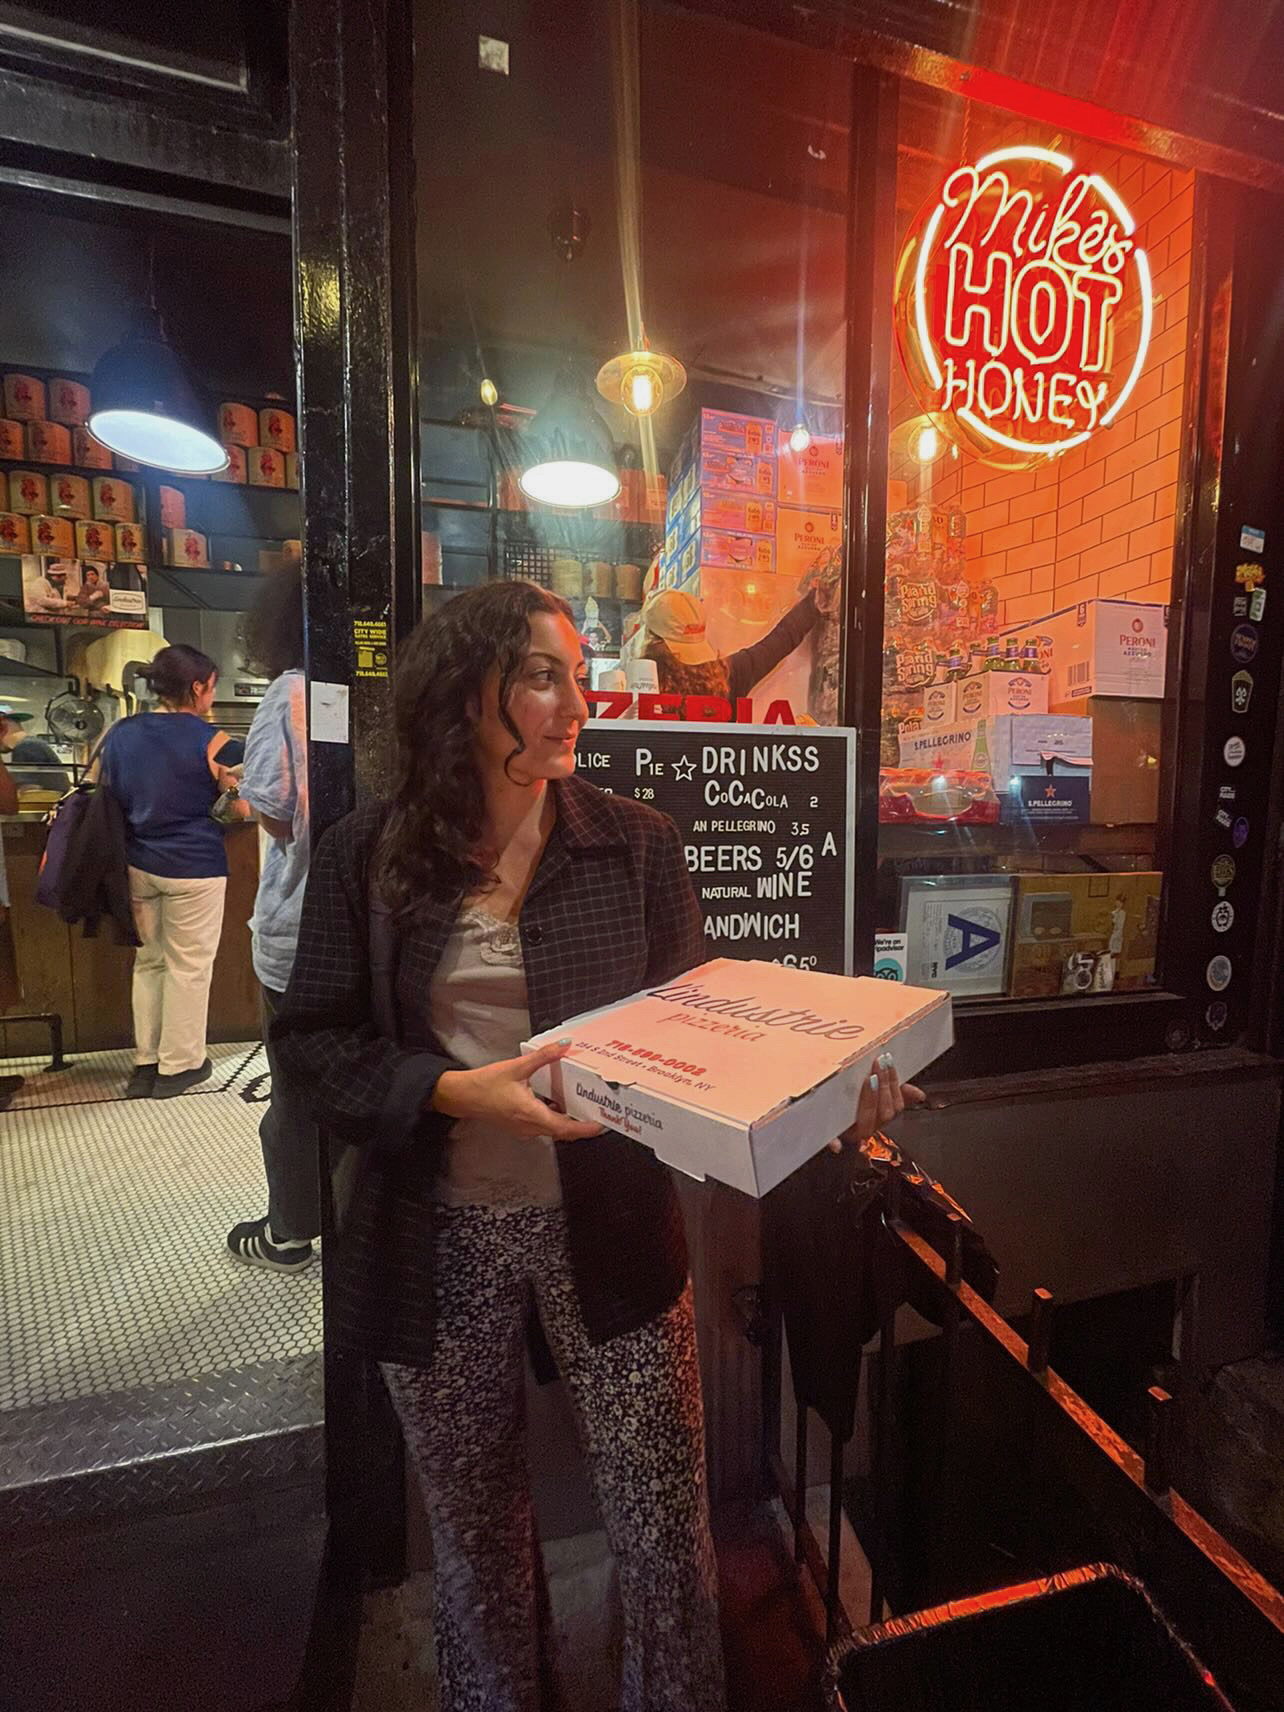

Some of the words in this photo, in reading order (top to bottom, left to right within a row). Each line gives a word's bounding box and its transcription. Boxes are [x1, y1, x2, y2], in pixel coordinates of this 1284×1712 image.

[945, 241, 1122, 372] HOT
[941, 357, 1108, 429] HONEY
[794, 532, 825, 545] PERONI
[1119, 634, 1156, 648] PERONI
[898, 720, 922, 734] Pola
[574, 752, 611, 768] LICE
[701, 744, 820, 776] DRINKSS
[809, 796, 819, 808] 2
[711, 820, 776, 834] PELLEGRINO
[684, 845, 762, 872] BEERS
[776, 844, 814, 871] 5/6
[821, 831, 837, 857] A
[702, 886, 751, 900] NATURAL
[757, 871, 812, 901] WINE
[703, 911, 800, 941] ANDWICH
[945, 913, 1001, 971] A
[656, 1012, 766, 1042] pizzeria
[614, 1054, 642, 1068] Street
[695, 1081, 717, 1091] NY
[624, 1102, 664, 1131] pizzeria
